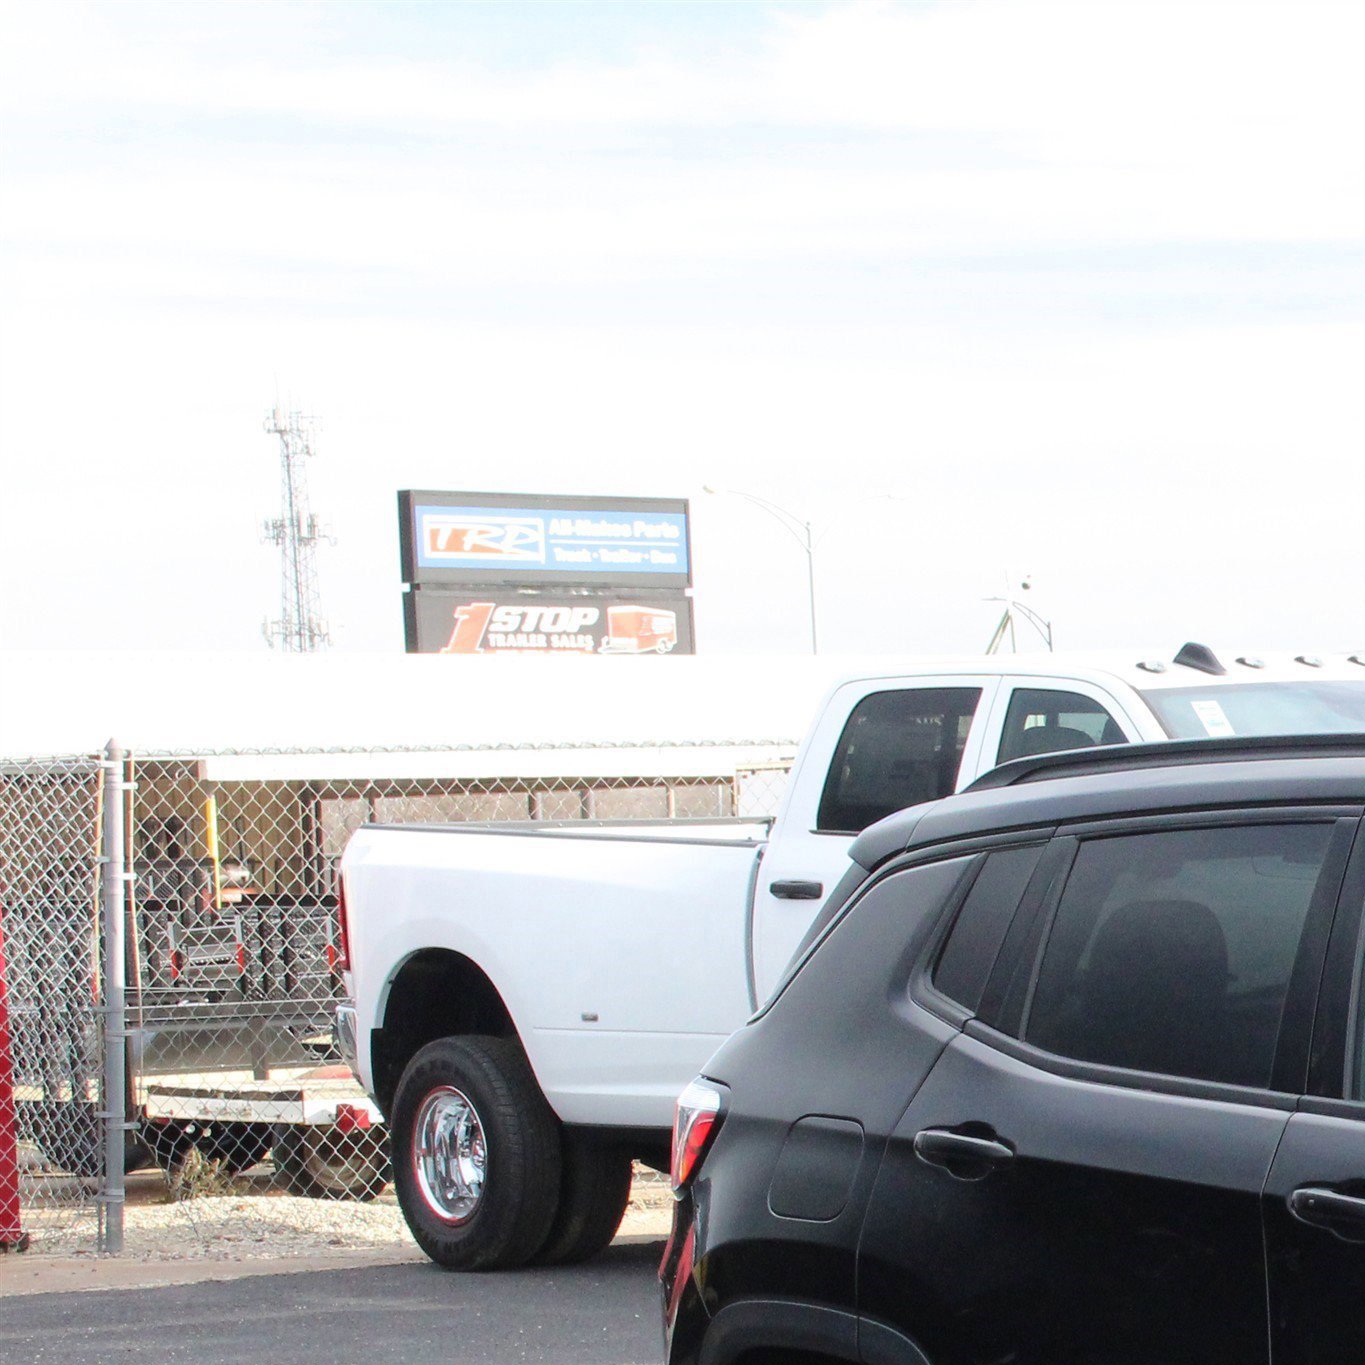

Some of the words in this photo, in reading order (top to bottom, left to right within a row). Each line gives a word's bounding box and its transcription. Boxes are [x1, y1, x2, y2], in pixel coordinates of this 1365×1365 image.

[439, 602, 496, 655] 1
[488, 605, 600, 633] STOP
[488, 633, 547, 648] TRAILER
[551, 633, 594, 649] SALES
